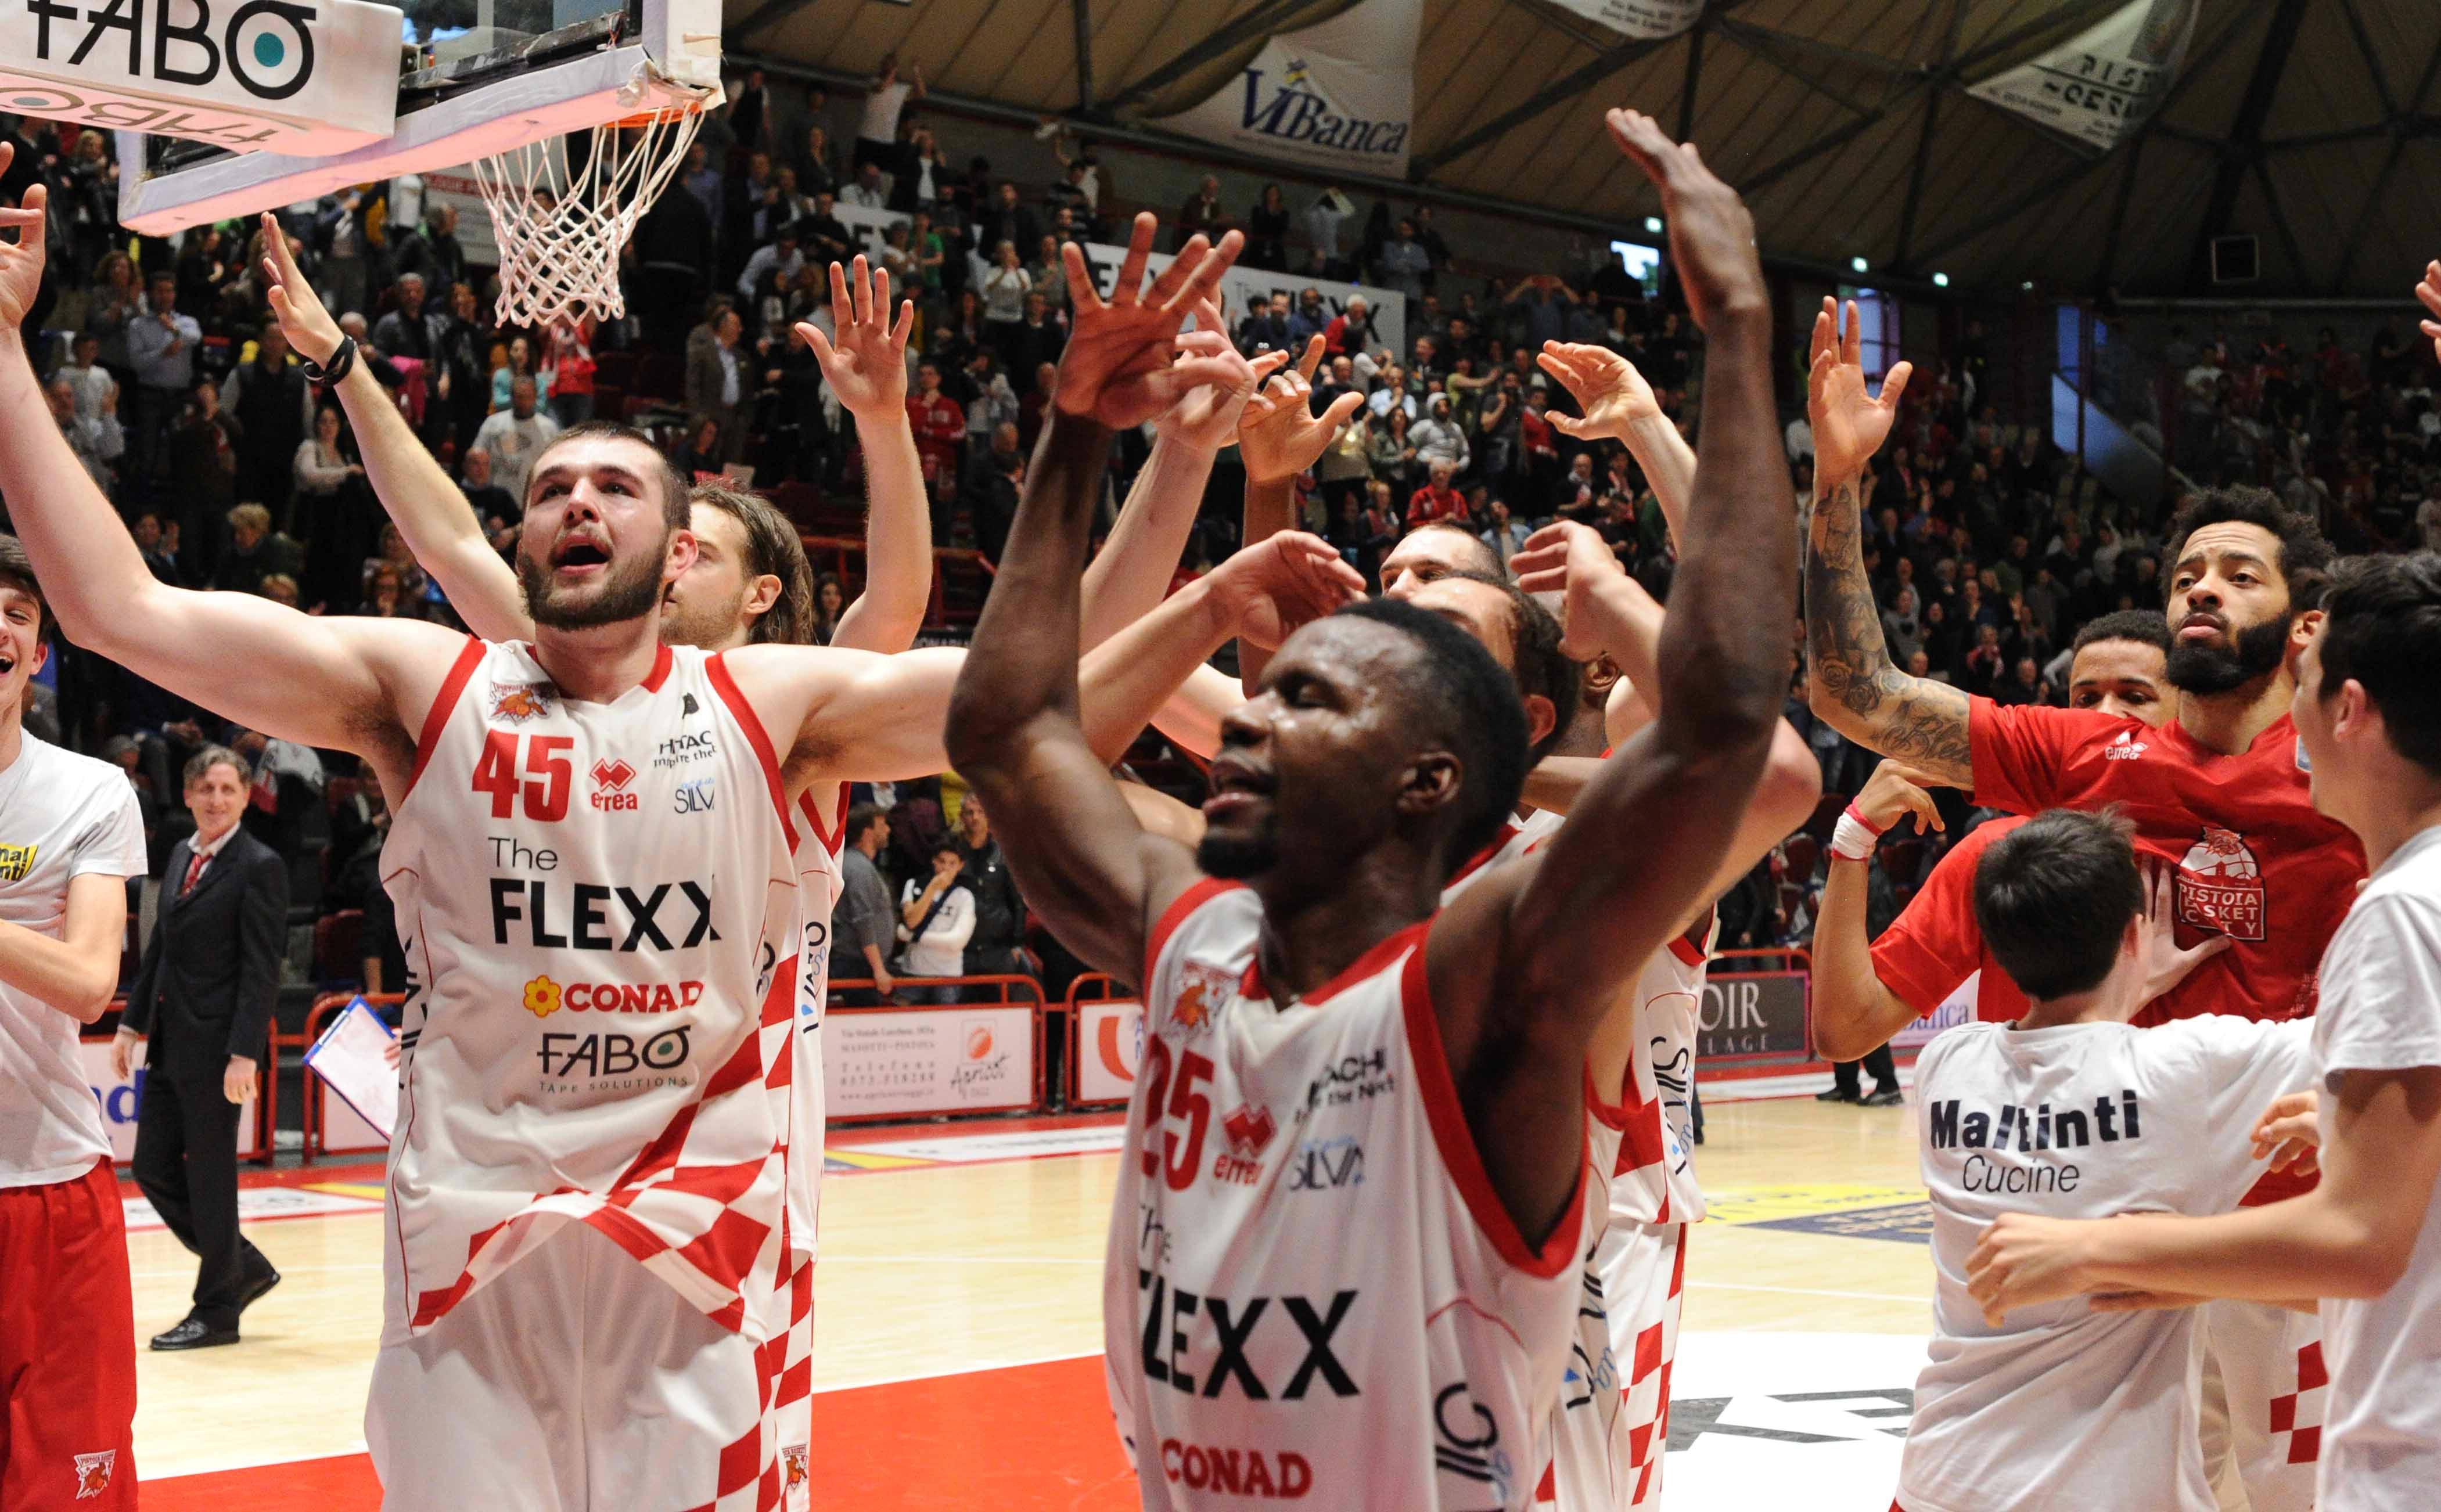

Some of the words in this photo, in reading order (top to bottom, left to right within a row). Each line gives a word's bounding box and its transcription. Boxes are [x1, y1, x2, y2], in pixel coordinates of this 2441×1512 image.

[27, 0, 317, 100] FABO
[2105, 746, 2141, 760] errea
[472, 728, 574, 823] 45
[591, 791, 638, 812] errea
[674, 787, 715, 814] SILV
[0, 847, 29, 863] nal
[488, 837, 558, 871] The
[0, 862, 25, 881] nti
[2179, 883, 2258, 906] PISTOIA
[490, 874, 722, 952] FLEXX
[2185, 909, 2257, 935] CTY
[564, 981, 704, 1013] CONAD
[1699, 982, 1768, 1032] OIR
[537, 1024, 691, 1078] FABO
[589, 1077, 689, 1090] SOLUTIONS
[1930, 1089, 2140, 1152] Maltinti
[1962, 1154, 2080, 1193] Cucine
[1162, 1438, 1313, 1500] CONAD
